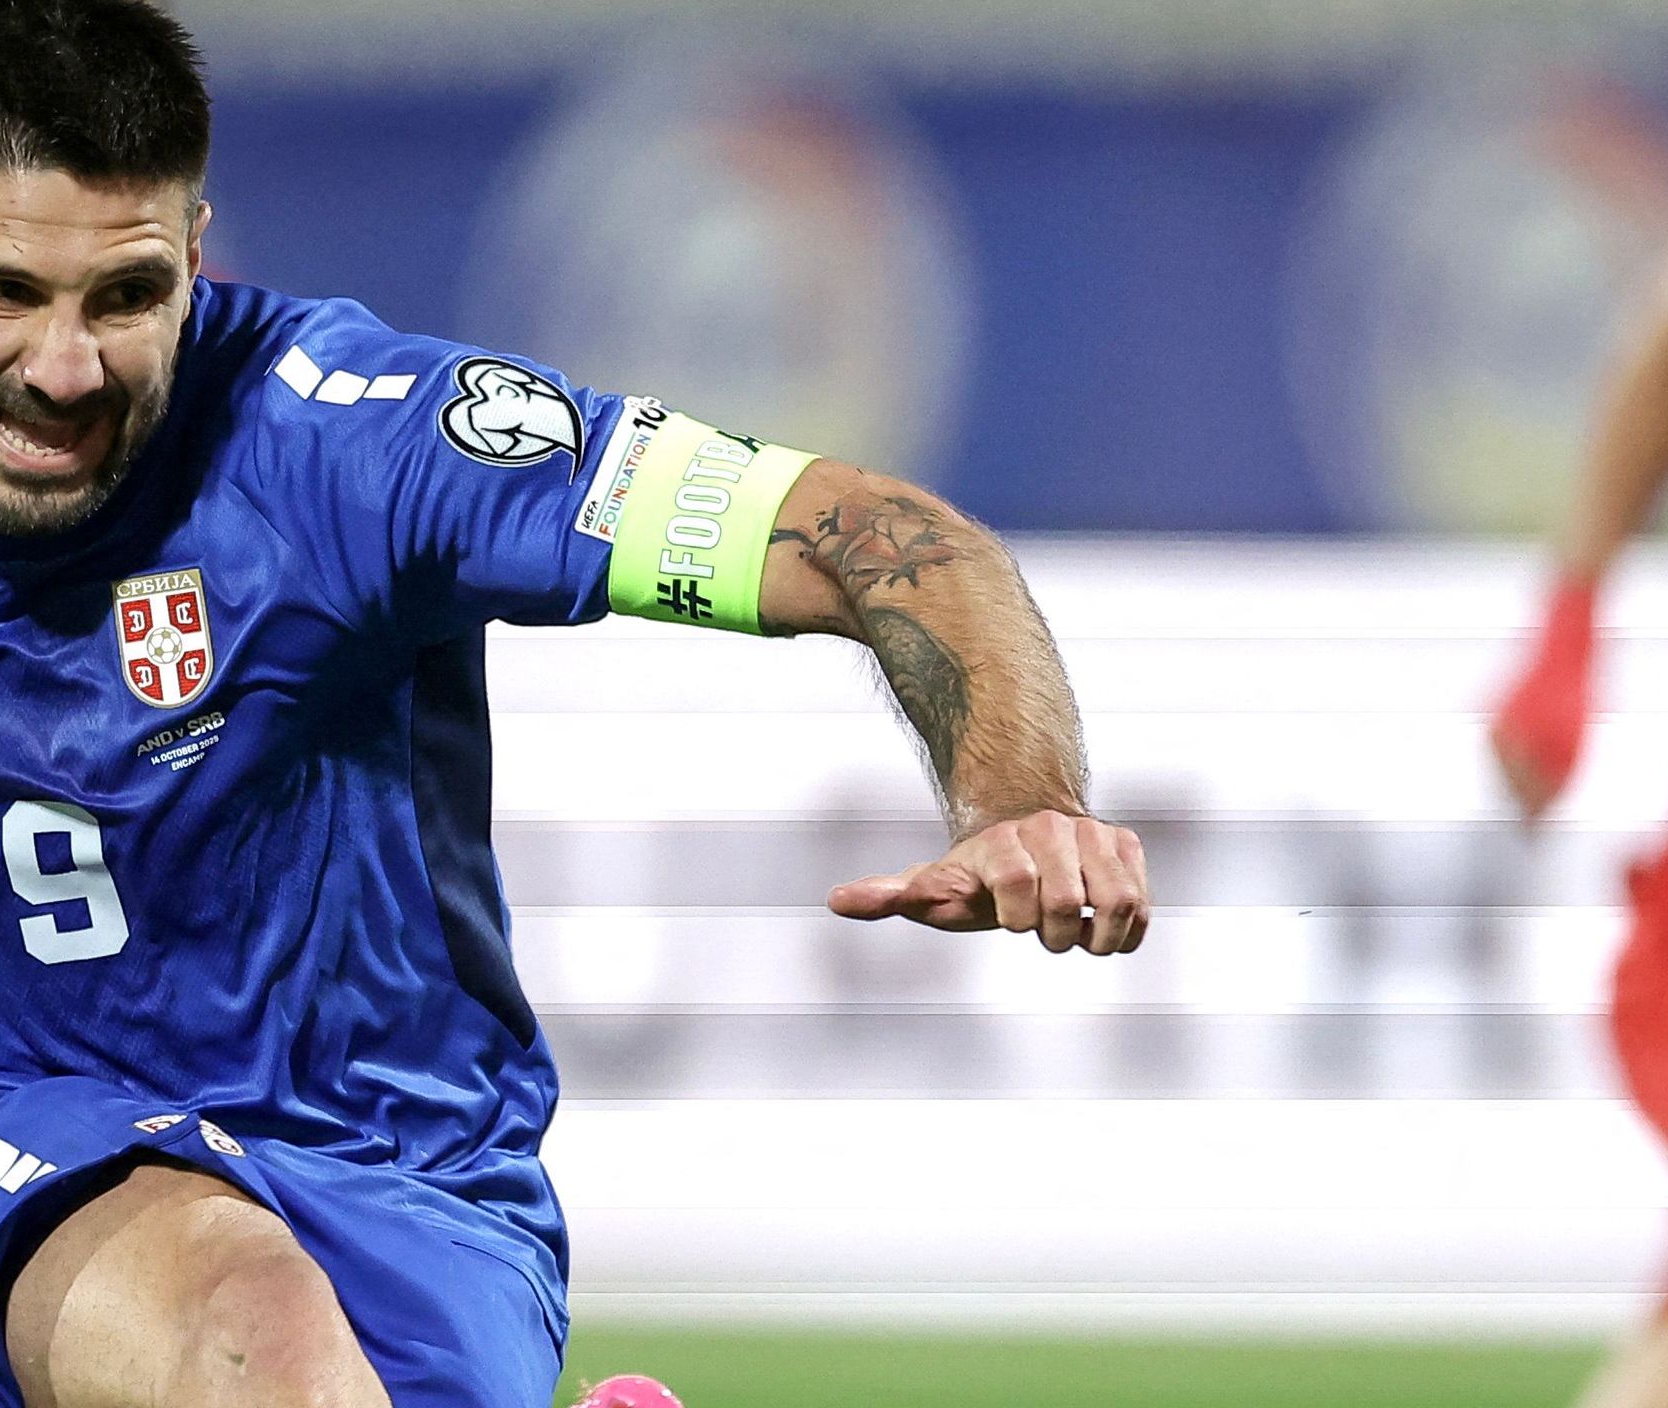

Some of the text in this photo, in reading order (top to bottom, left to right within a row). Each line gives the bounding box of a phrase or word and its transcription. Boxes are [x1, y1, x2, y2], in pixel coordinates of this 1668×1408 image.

[598, 433, 652, 537] FOUNDATION
[581, 499, 600, 530] UEFA
[116, 573, 197, 598] СРБИЈА
[137, 730, 174, 757] AND
[187, 711, 226, 737] SRB
[160, 743, 199, 763] OCTOBER
[171, 752, 205, 771] ENCAMP
[2, 800, 130, 965] 9
